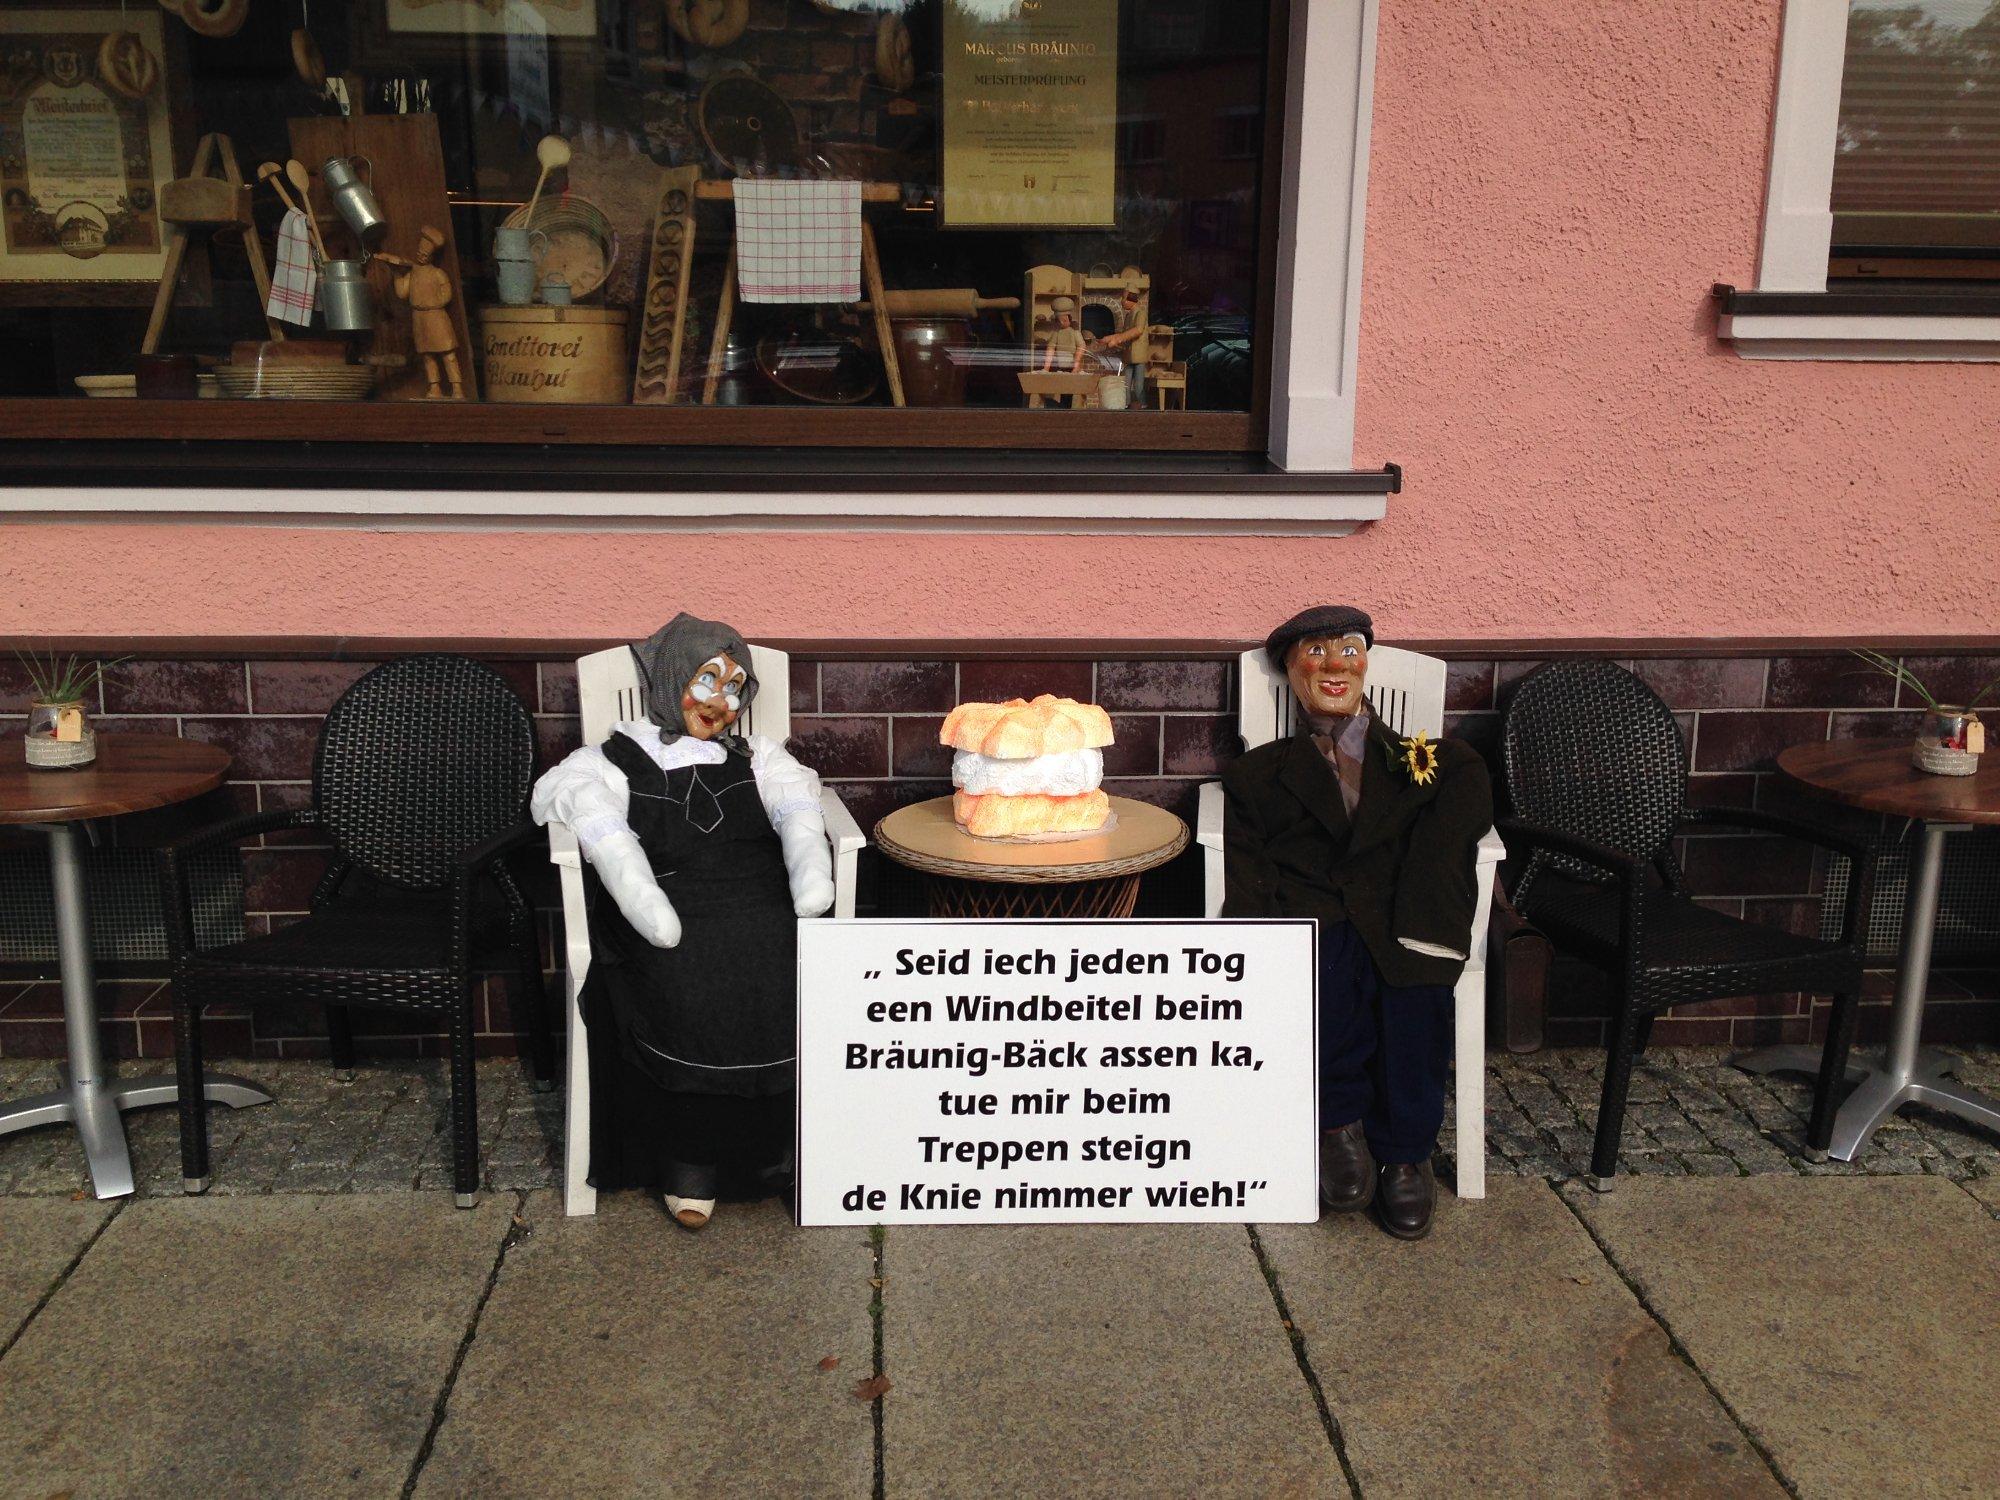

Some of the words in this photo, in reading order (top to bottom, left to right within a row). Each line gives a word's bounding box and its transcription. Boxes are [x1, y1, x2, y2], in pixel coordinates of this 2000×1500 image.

[896, 948, 970, 976] Seid
[984, 948, 1056, 975] iech
[1065, 948, 1169, 983] jeden
[1182, 947, 1245, 982] Tog
[867, 1001, 932, 1023] een
[946, 994, 1142, 1022] Windbeitel
[1156, 994, 1243, 1021] beim
[846, 1039, 1087, 1077] Bräunig-Bäck
[1100, 1046, 1197, 1068] assen
[1212, 1040, 1264, 1071] ka,
[939, 1090, 998, 1116] tue
[1012, 1088, 1070, 1115] mir
[1084, 1087, 1171, 1115] beim
[919, 1136, 1069, 1170] Treppen
[1082, 1134, 1191, 1169] steign
[843, 1184, 887, 1212] de
[901, 1182, 981, 1211] Knie
[995, 1182, 1133, 1209] nimmer
[1145, 1180, 1267, 1208] wieh!“
